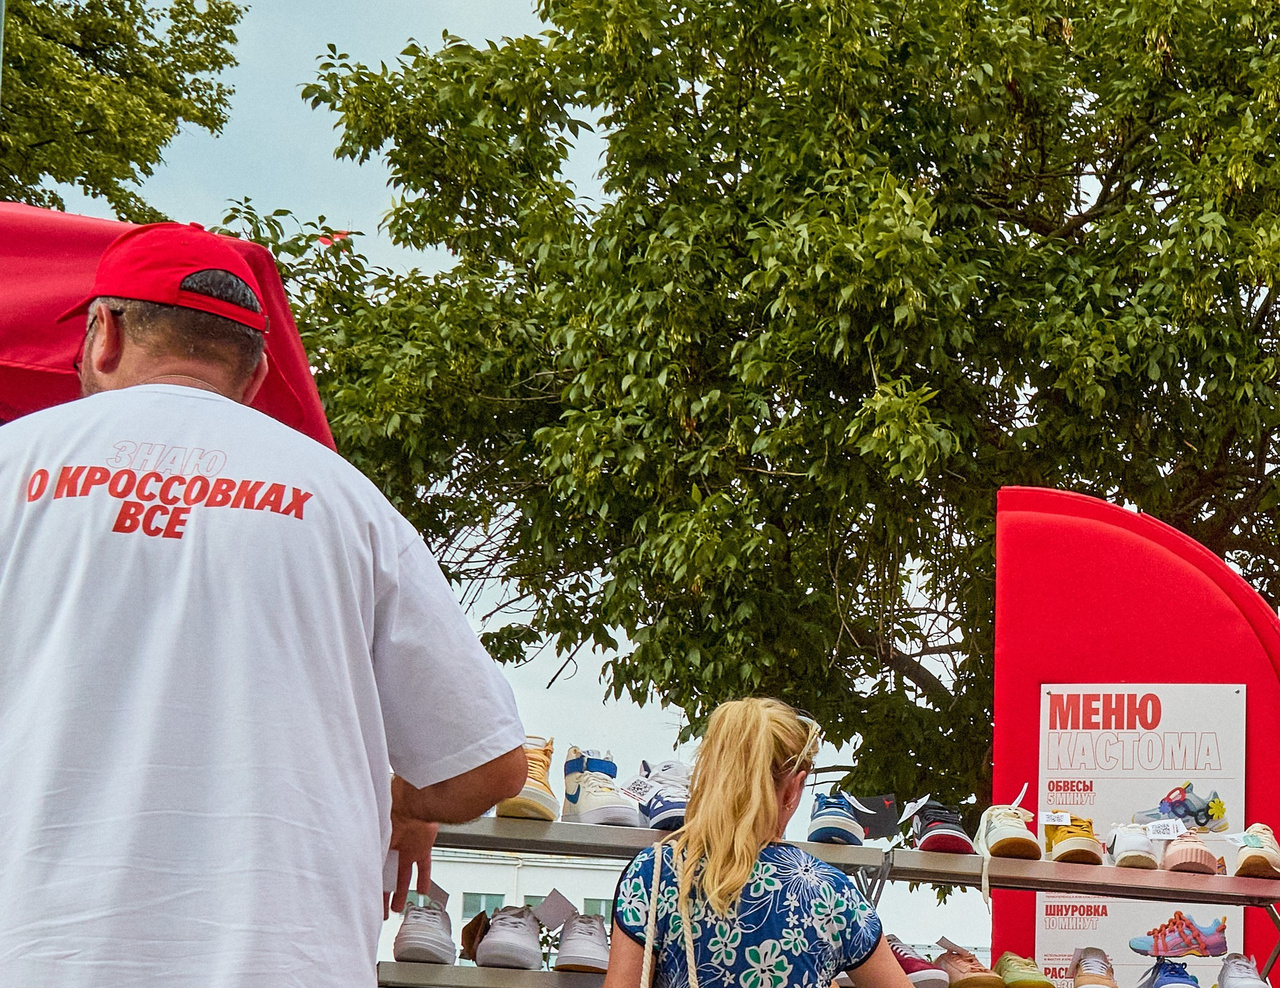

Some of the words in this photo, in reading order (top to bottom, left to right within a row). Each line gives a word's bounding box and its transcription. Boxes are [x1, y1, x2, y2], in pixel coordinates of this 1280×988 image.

[106, 440, 228, 478] ЗНАЮ
[27, 469, 50, 502] О
[54, 466, 313, 520] КРОССОВКАХ
[112, 500, 191, 539] ВСЕ
[1049, 693, 1162, 730] МЕНЮ
[1047, 731, 1222, 771] КАСТОМА
[1047, 792, 1055, 805] 5
[1056, 792, 1096, 805] МИНУТ
[1048, 780, 1093, 792] ОБВЕСЫ
[1044, 917, 1057, 930] 10
[1058, 917, 1099, 930] МИНУТ
[1045, 904, 1108, 917] ШНУРОВКА
